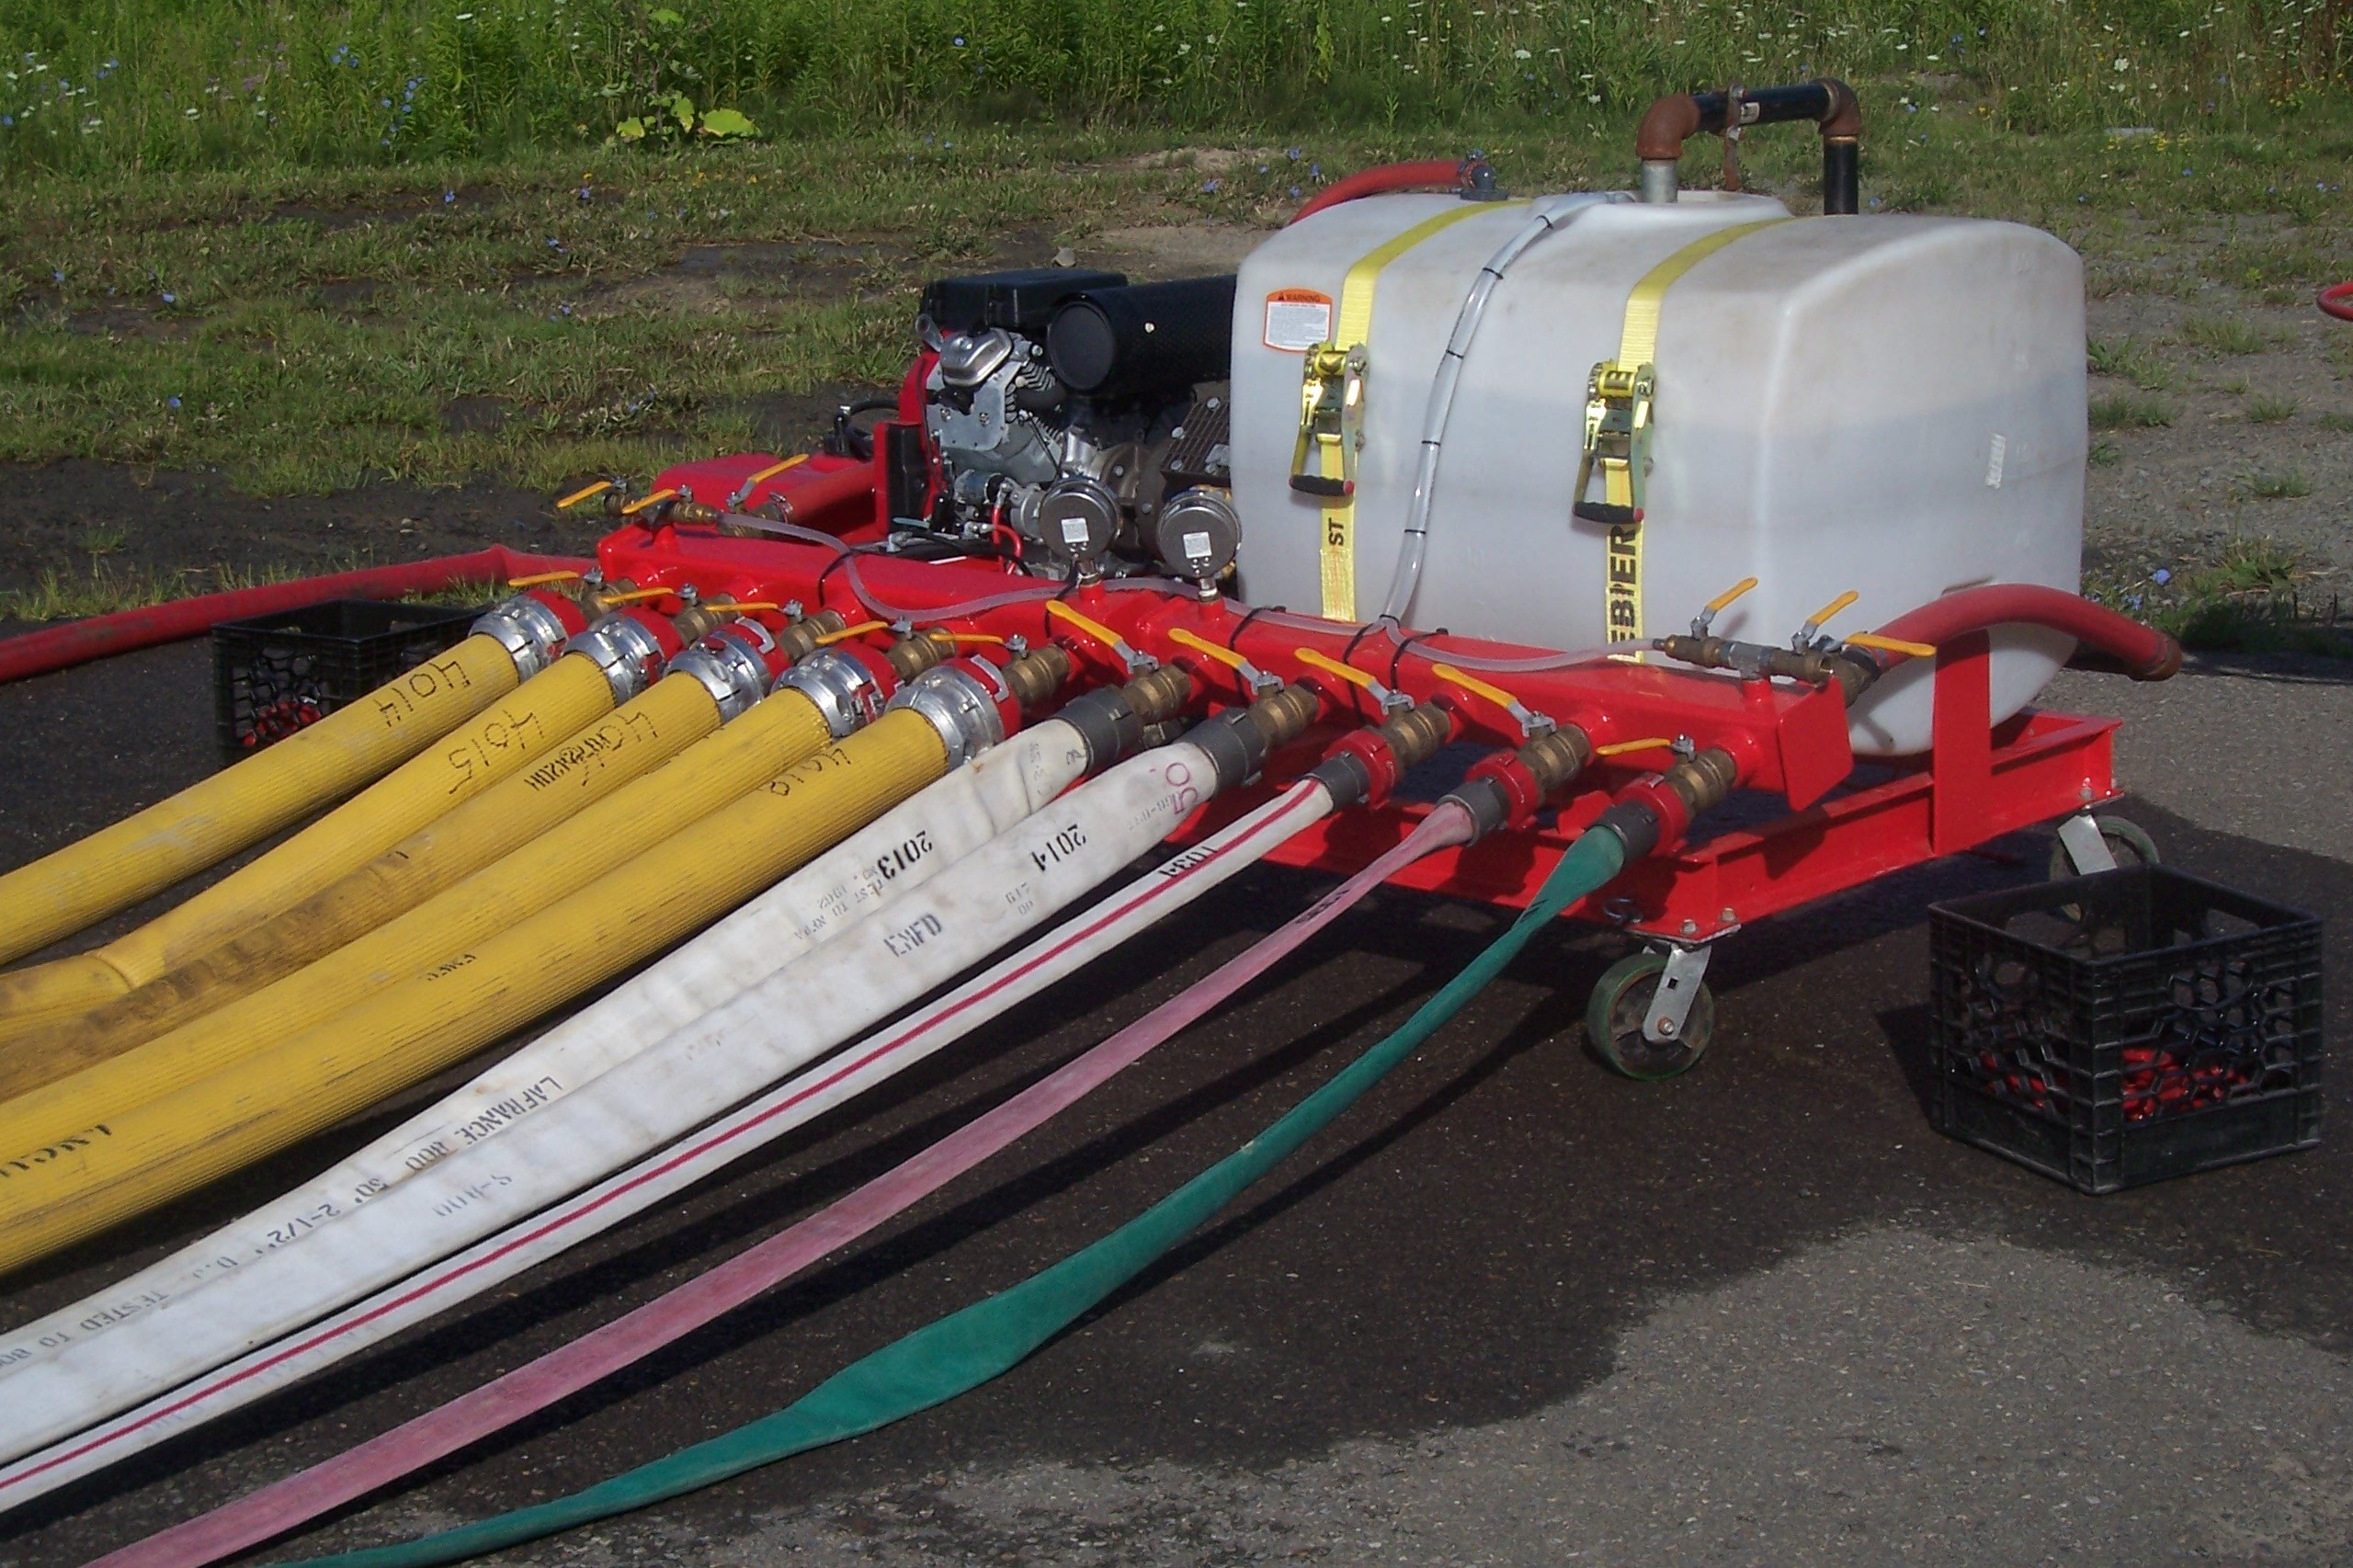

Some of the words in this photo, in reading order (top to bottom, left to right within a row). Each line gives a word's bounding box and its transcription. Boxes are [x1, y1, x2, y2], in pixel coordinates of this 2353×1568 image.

[1328, 517, 1345, 546] ST
[372, 660, 472, 728] 4014
[447, 709, 545, 795] 4015
[877, 830, 933, 880] 2013
[1030, 824, 1086, 872] 2014
[1158, 846, 1218, 878] 1034
[454, 1075, 563, 1146] LAFRANCE
[79, 1290, 169, 1331] TESTED
[0, 1347, 33, 1369] 80
[39, 1332, 71, 1348] TO
